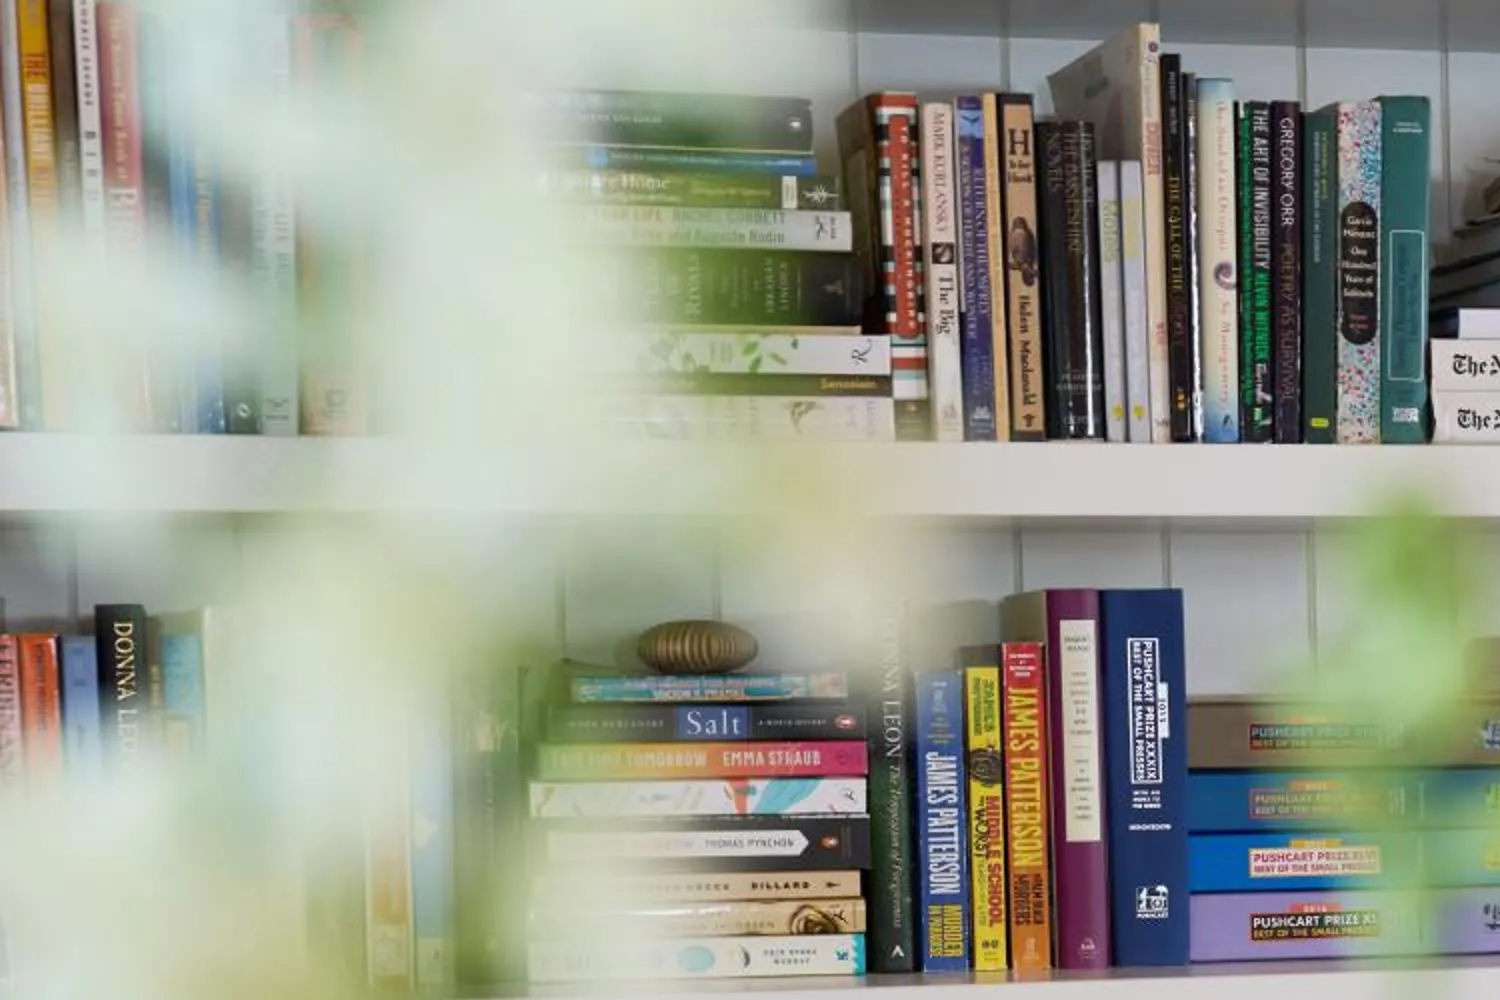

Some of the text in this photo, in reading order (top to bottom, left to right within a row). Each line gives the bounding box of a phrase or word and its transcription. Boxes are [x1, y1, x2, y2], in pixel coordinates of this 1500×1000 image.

[1009, 128, 1031, 156] H
[1169, 176, 1181, 203] THE
[1252, 109, 1270, 270] THE ART OF INVISIBILITY
[1279, 117, 1295, 326] GREGORY ORR POETRY AS
[932, 113, 955, 335] MARK KURLANSKY The Big
[1018, 295, 1036, 405] Helen Macdonald
[1452, 353, 1488, 377] The
[1457, 408, 1491, 431] The
[113, 621, 137, 702] DONNA
[685, 710, 742, 736] Salt
[884, 701, 905, 784] LEON The
[1133, 666, 1146, 781] OF THE SMALL PRESSES
[1143, 640, 1158, 779] PUSHCART PRIZE XXXIX
[721, 750, 822, 767] EMMA STRAUB
[1007, 686, 1044, 867] JAMES PATTERSON
[704, 838, 795, 849] THOMAS PYNCHON
[924, 751, 961, 896] JAMES PATTERSON
[973, 808, 989, 859] WORST
[986, 795, 1003, 927] MIDDLE SCHOOL
[1253, 852, 1314, 863] PUSHCART
[946, 904, 963, 957] MURDER
[1252, 914, 1361, 929] PUSHCART PRIZE
